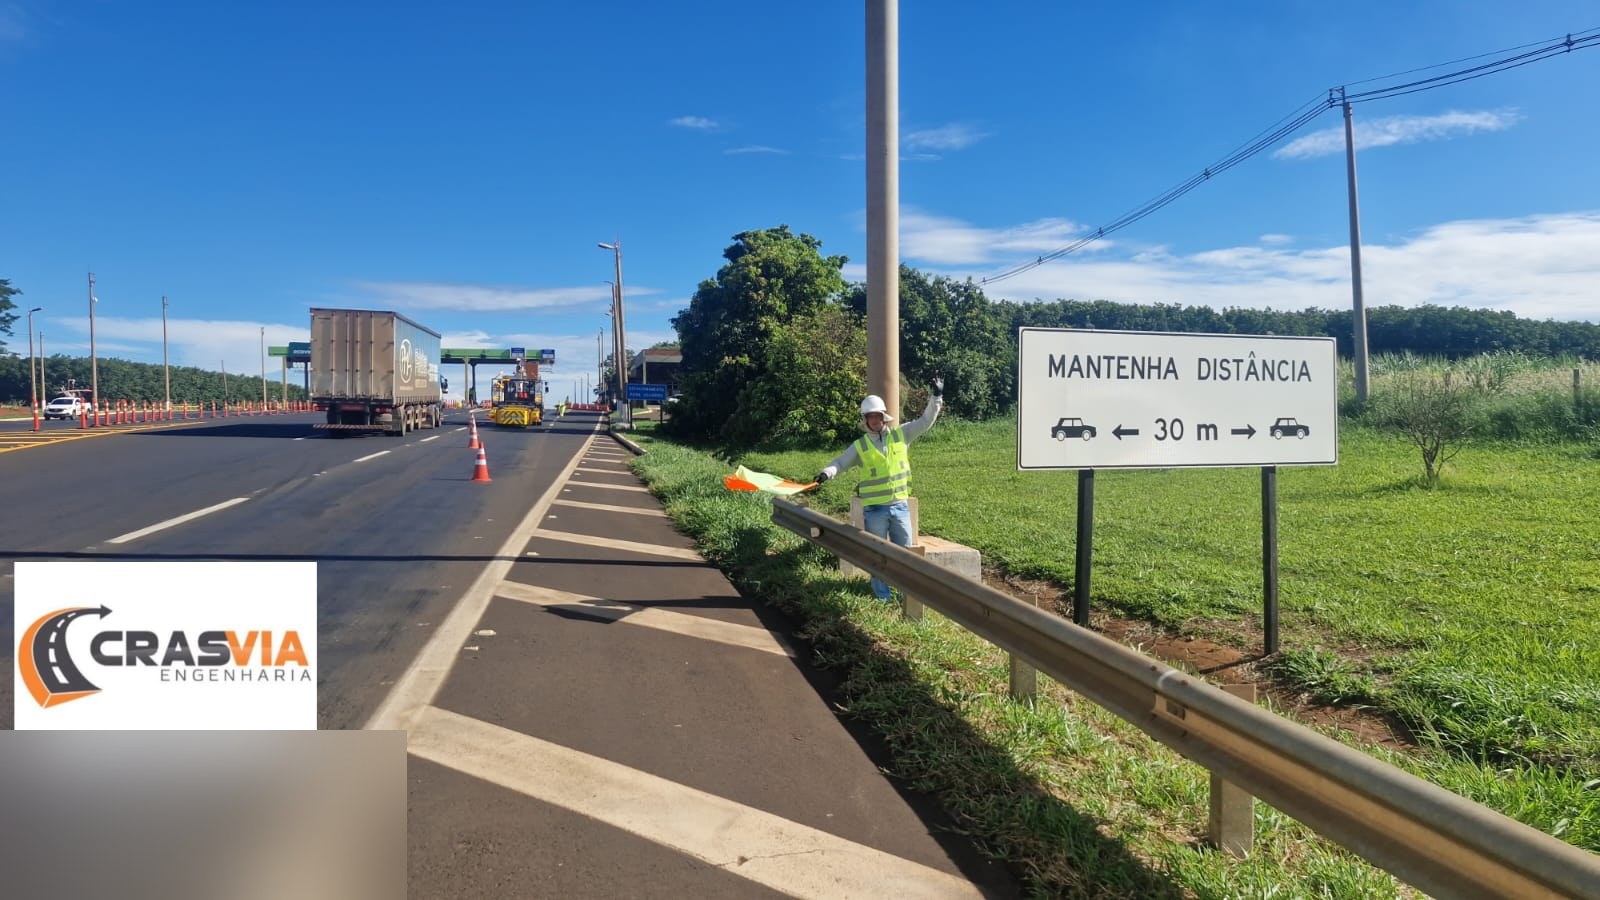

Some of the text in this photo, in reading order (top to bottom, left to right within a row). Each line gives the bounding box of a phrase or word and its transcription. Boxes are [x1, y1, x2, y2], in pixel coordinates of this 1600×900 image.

[1048, 350, 1312, 382] MANTENHA DISTÂNCIA
[1154, 417, 1218, 441] 30 m
